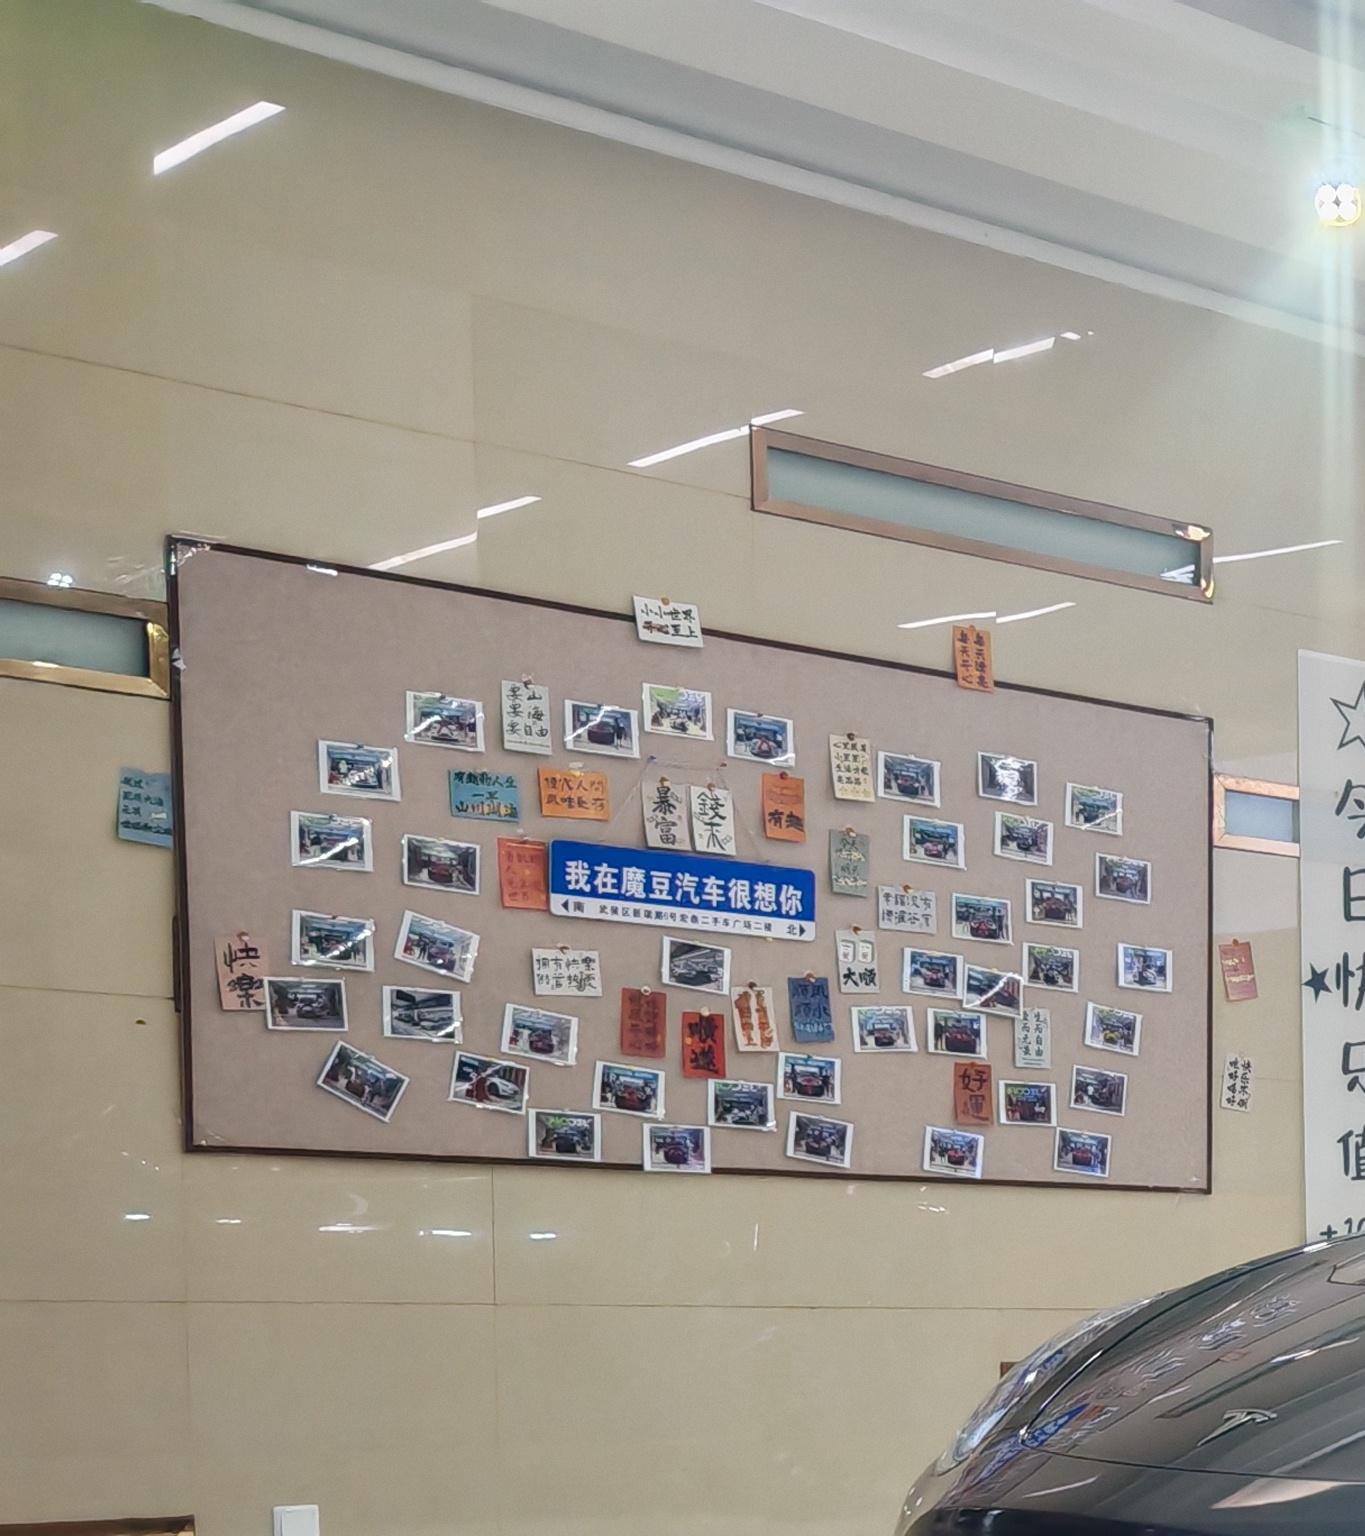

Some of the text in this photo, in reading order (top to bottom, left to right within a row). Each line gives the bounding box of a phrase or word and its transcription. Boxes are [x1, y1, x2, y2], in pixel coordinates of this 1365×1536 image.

[564, 858, 803, 917] 我在魔豆汽车很想你
[786, 924, 798, 937] 北
